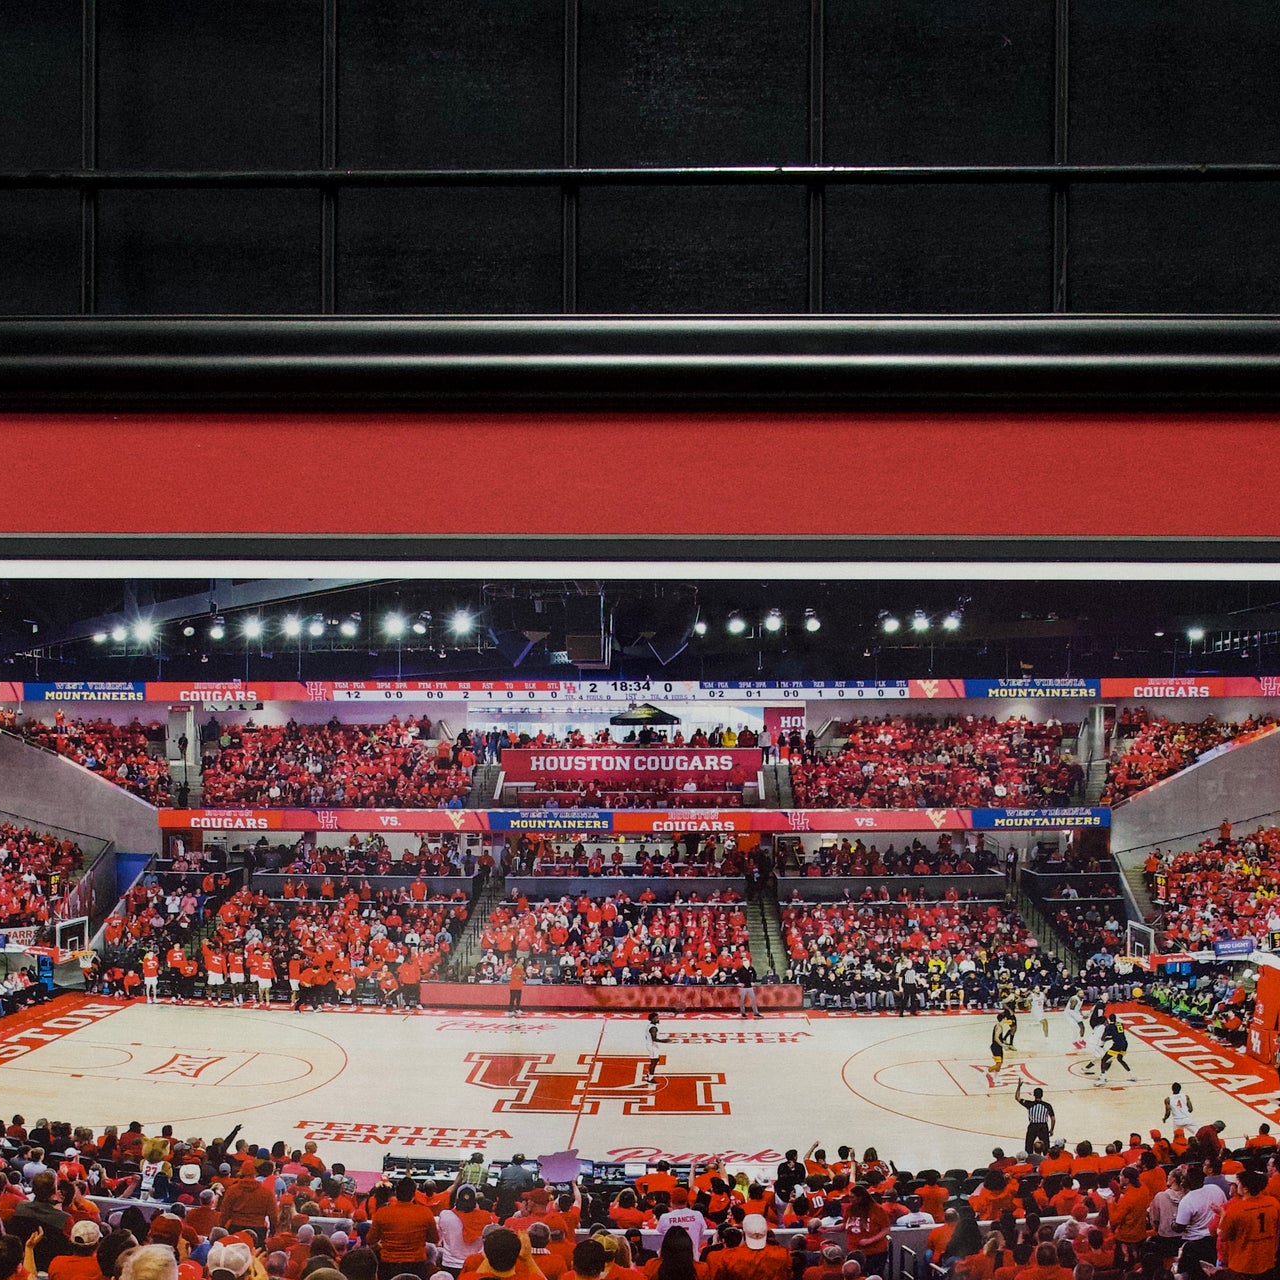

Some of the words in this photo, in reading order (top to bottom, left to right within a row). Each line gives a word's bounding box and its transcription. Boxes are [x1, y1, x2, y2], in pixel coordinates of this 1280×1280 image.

[589, 683, 597, 693] 2
[610, 682, 651, 692] 18:34
[664, 683, 672, 693] 0
[988, 688, 1096, 698] MOUNTAINEERS
[1133, 686, 1210, 698] COUGARS
[45, 691, 143, 701] MOUNTAINEERS
[180, 690, 257, 701] COUGARS
[463, 691, 470, 699] 2
[507, 691, 513, 699] 0
[528, 691, 535, 699] 0
[551, 691, 557, 699] 0
[838, 690, 844, 698] 0
[857, 690, 863, 698] 0
[878, 690, 884, 698] 0
[899, 690, 905, 698] 0
[530, 756, 633, 771] HOUSTON
[633, 755, 733, 771] COUGARS
[190, 818, 268, 829] COUGARS
[380, 815, 401, 826] VS.
[510, 819, 609, 829] MOUNTAINEERS
[854, 817, 877, 827] VS.
[994, 817, 1101, 827] MOUNTAINEERS
[652, 821, 735, 832] COUGARS
[1176, 1101, 1182, 1109] 4
[293, 1120, 513, 1139] FERTITTA
[304, 1131, 488, 1149] CENTER
[145, 1165, 158, 1177] 27
[813, 1196, 824, 1208] 10
[669, 1215, 696, 1225] FRANCIS
[1257, 1212, 1265, 1232] 1
